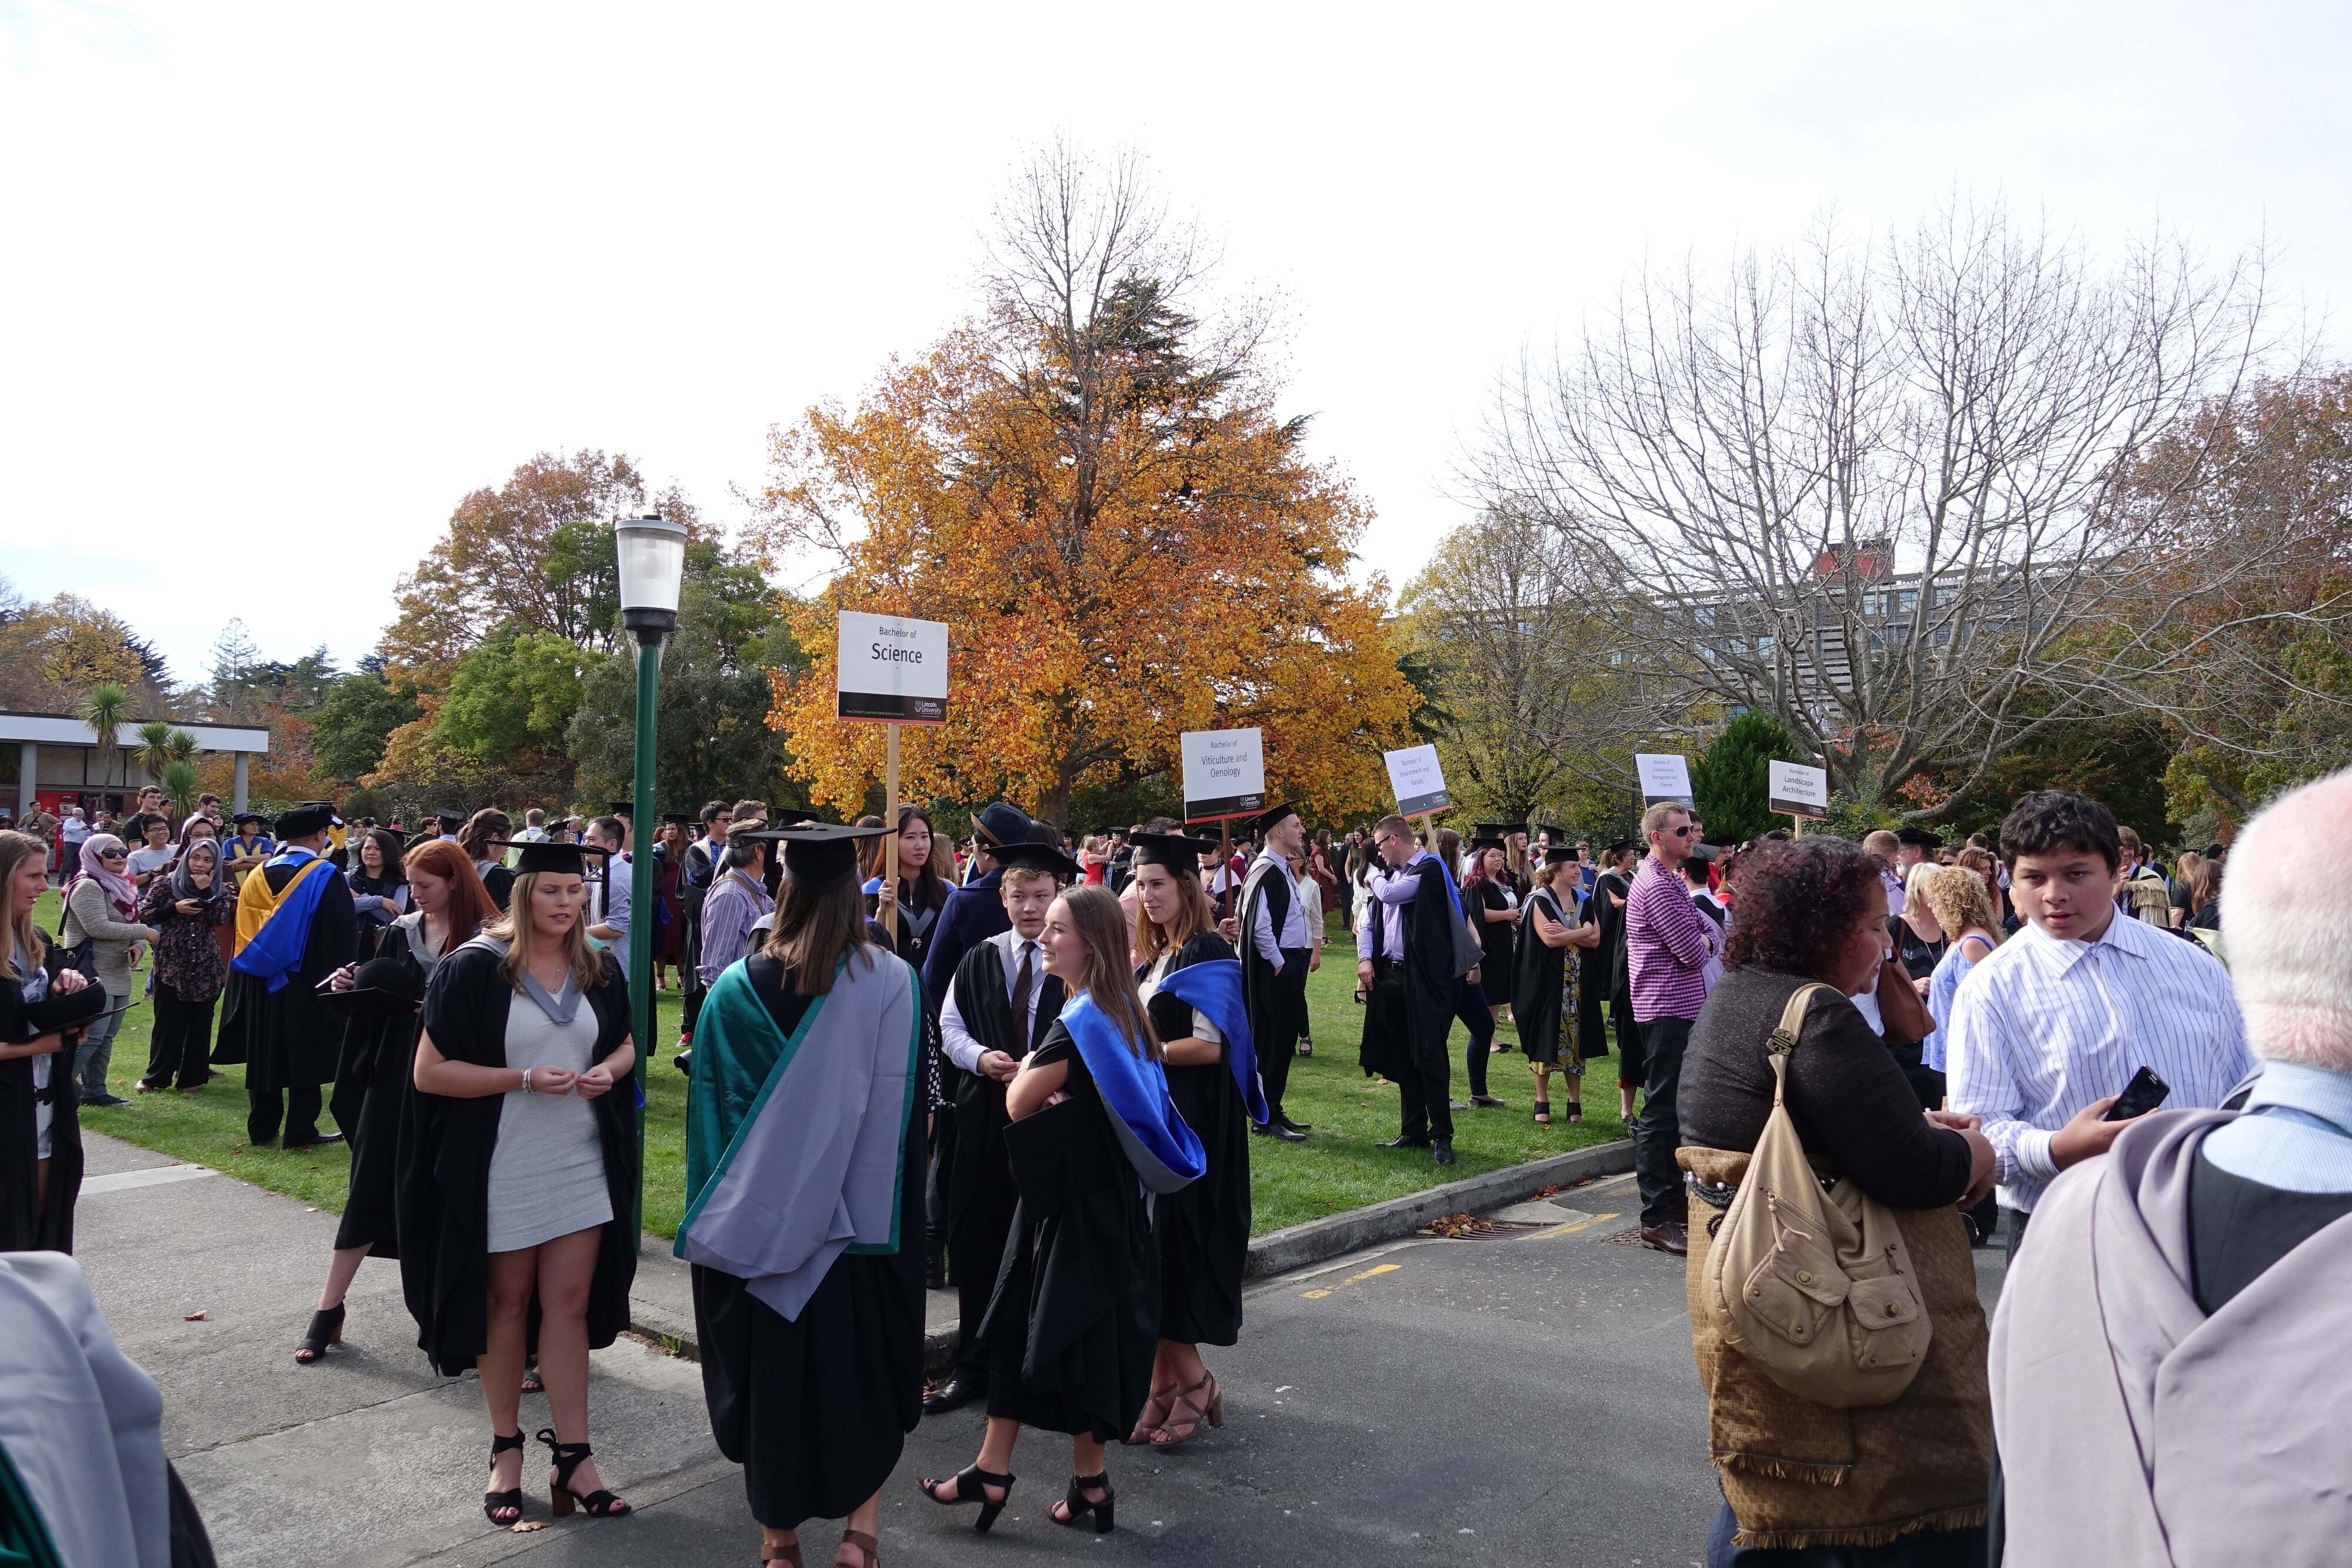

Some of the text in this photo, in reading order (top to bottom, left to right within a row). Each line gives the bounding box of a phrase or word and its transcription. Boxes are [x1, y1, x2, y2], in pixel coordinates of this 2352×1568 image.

[879, 627, 917, 639] Bachelor of
[872, 643, 922, 663] Science
[922, 706, 942, 715] University
[1210, 740, 1232, 749] Bachelor
[1201, 752, 1247, 765] Viticulture and
[1210, 766, 1241, 778] Oenology
[1400, 769, 1422, 778] Environment
[1784, 775, 1814, 787] Landscape
[1783, 785, 1816, 797] Architecture
